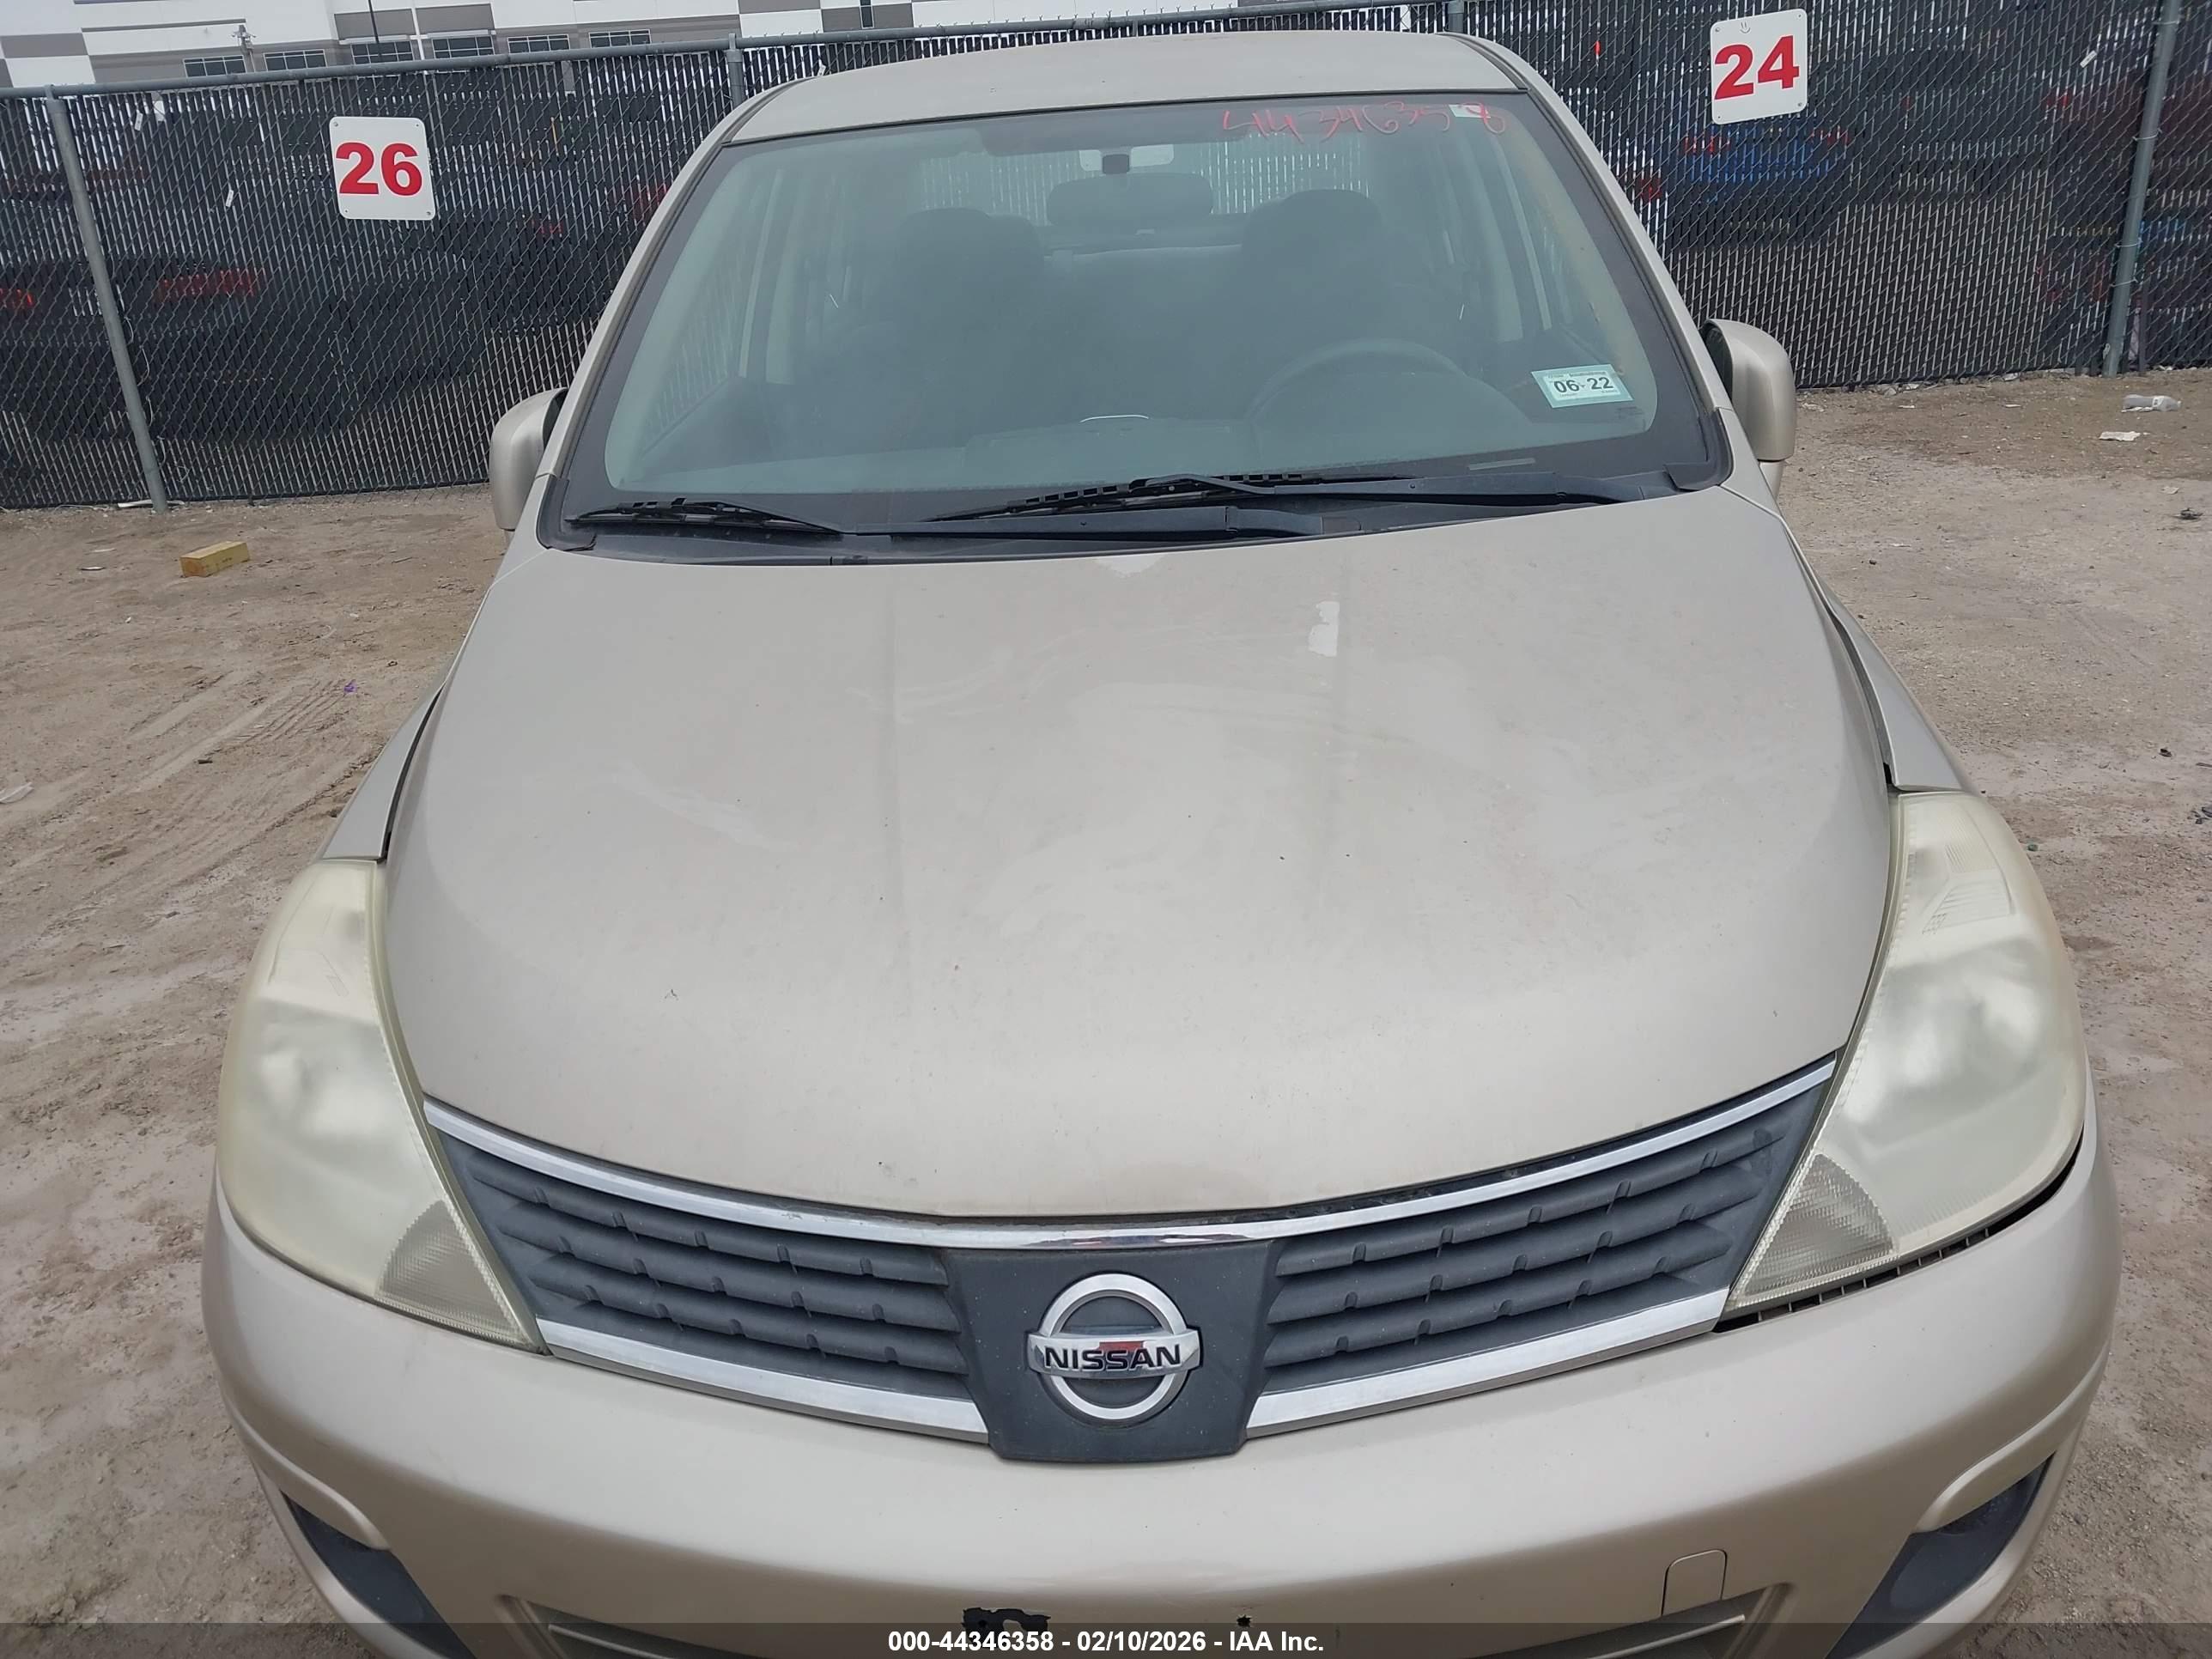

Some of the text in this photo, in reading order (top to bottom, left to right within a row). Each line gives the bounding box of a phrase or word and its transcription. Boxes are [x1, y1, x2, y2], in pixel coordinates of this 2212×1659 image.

[1715, 35, 1799, 100] 24
[336, 142, 422, 196] 26
[1553, 377, 1613, 393] 06 22
[1044, 1344, 1182, 1370] NISSAN
